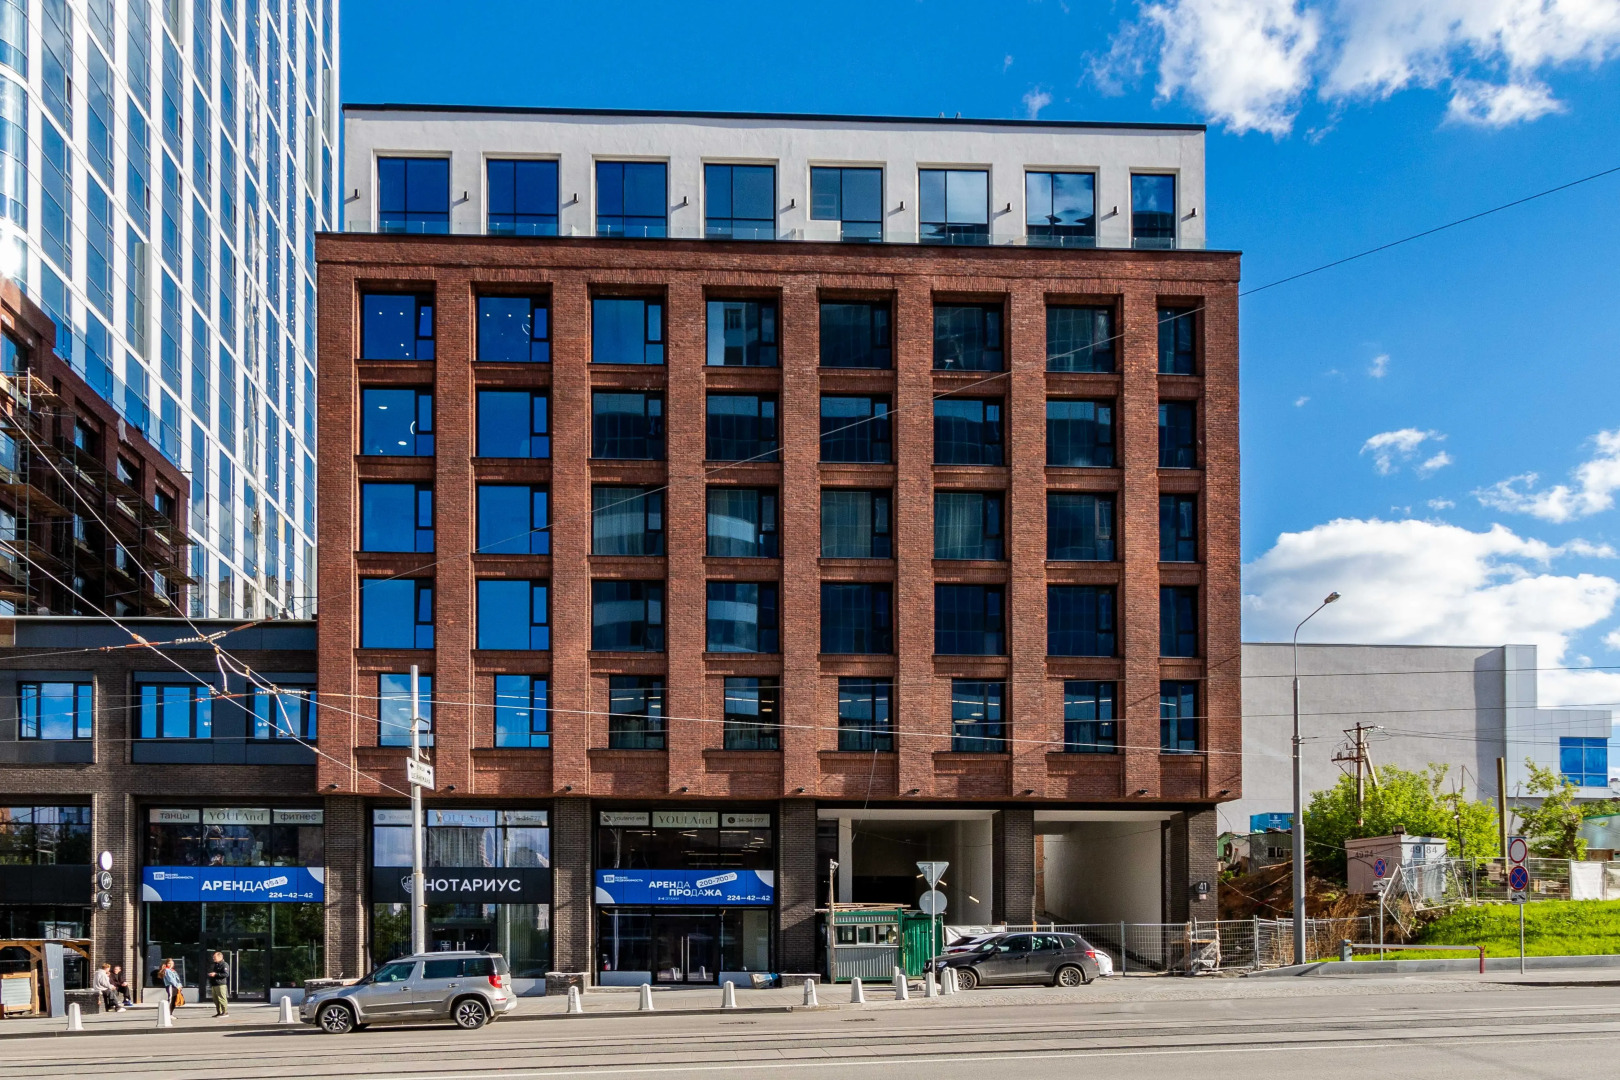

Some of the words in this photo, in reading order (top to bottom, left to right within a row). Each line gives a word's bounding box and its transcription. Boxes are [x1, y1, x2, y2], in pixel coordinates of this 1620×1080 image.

[160, 812, 190, 821] танцы
[280, 812, 317, 822] фитнес
[201, 880, 264, 892] АРЕНДА
[424, 878, 521, 892] НОТАРИУС
[648, 881, 690, 889] АРЕНДА
[1198, 882, 1206, 890] 41
[669, 889, 722, 897] ПРОДАЖА
